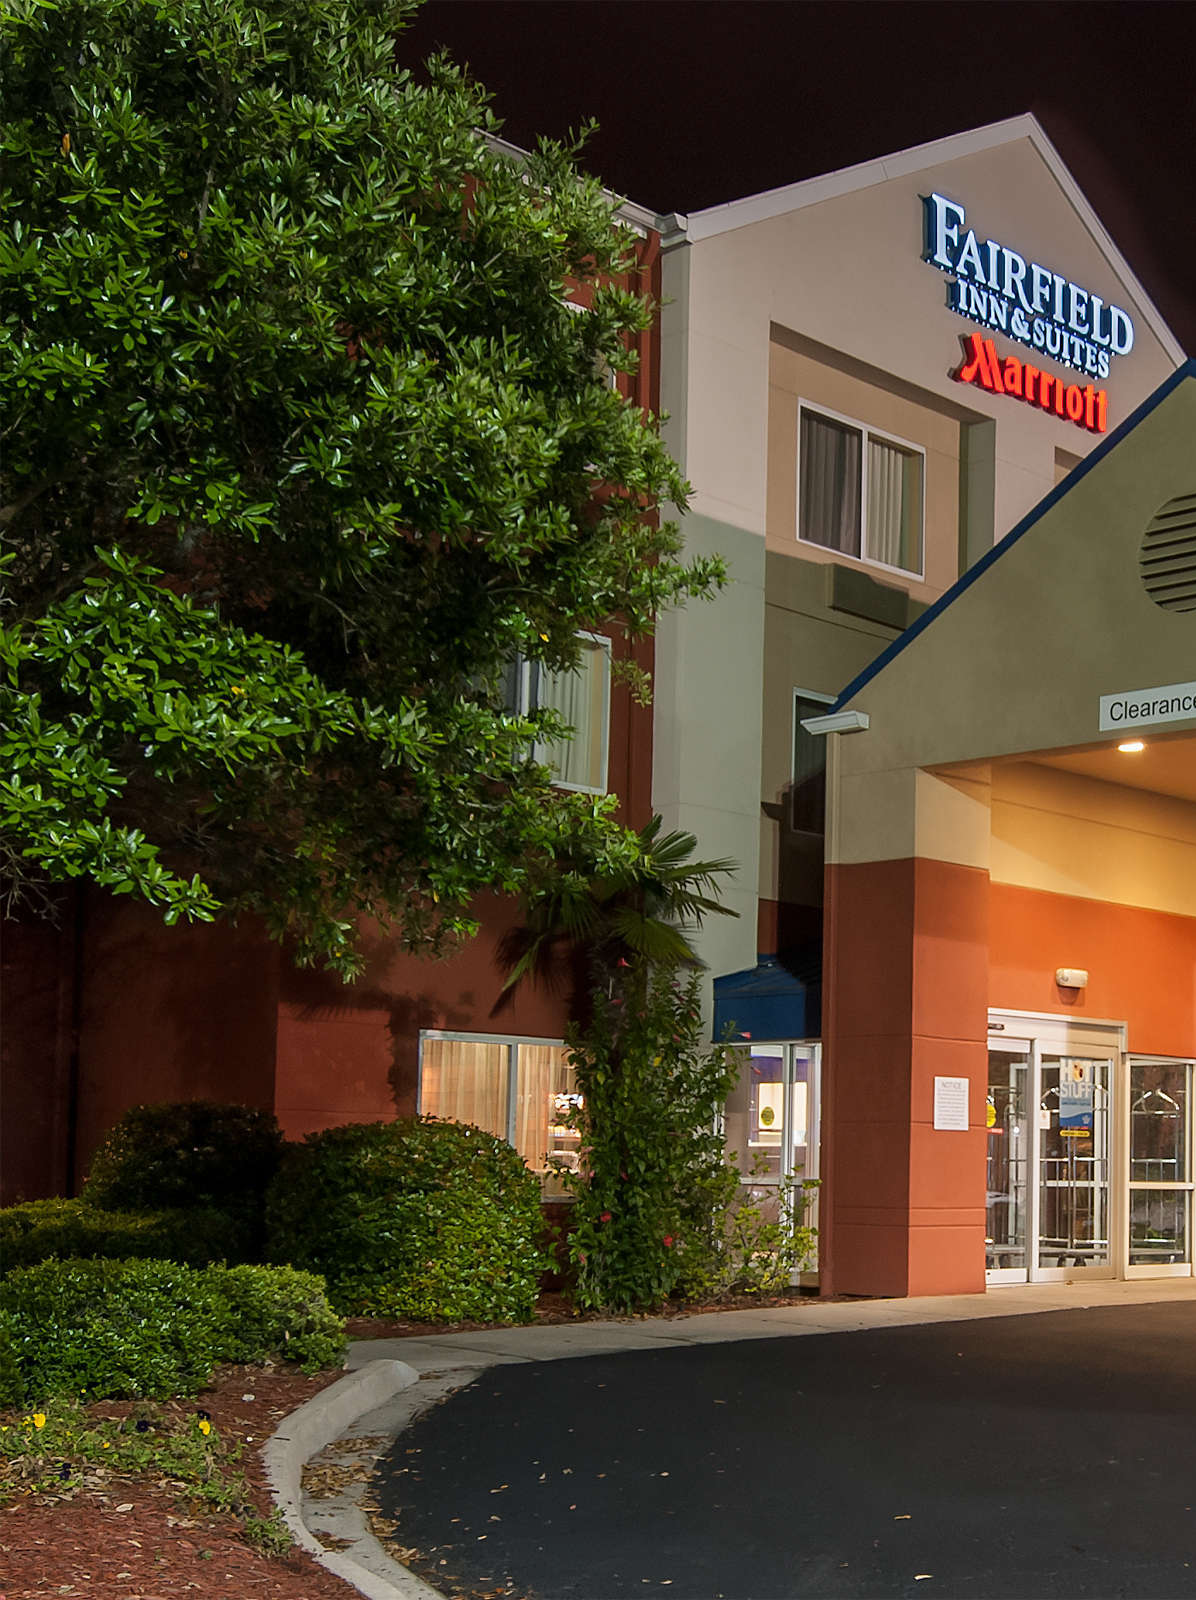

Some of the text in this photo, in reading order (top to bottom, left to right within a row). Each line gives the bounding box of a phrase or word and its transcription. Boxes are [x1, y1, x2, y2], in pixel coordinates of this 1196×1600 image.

[931, 192, 1135, 356] FAIRFIELD
[957, 278, 1009, 330] INN
[1033, 317, 1109, 379] SUITES
[959, 332, 1108, 433] Marriott
[1061, 1083, 1093, 1098] STUFF
